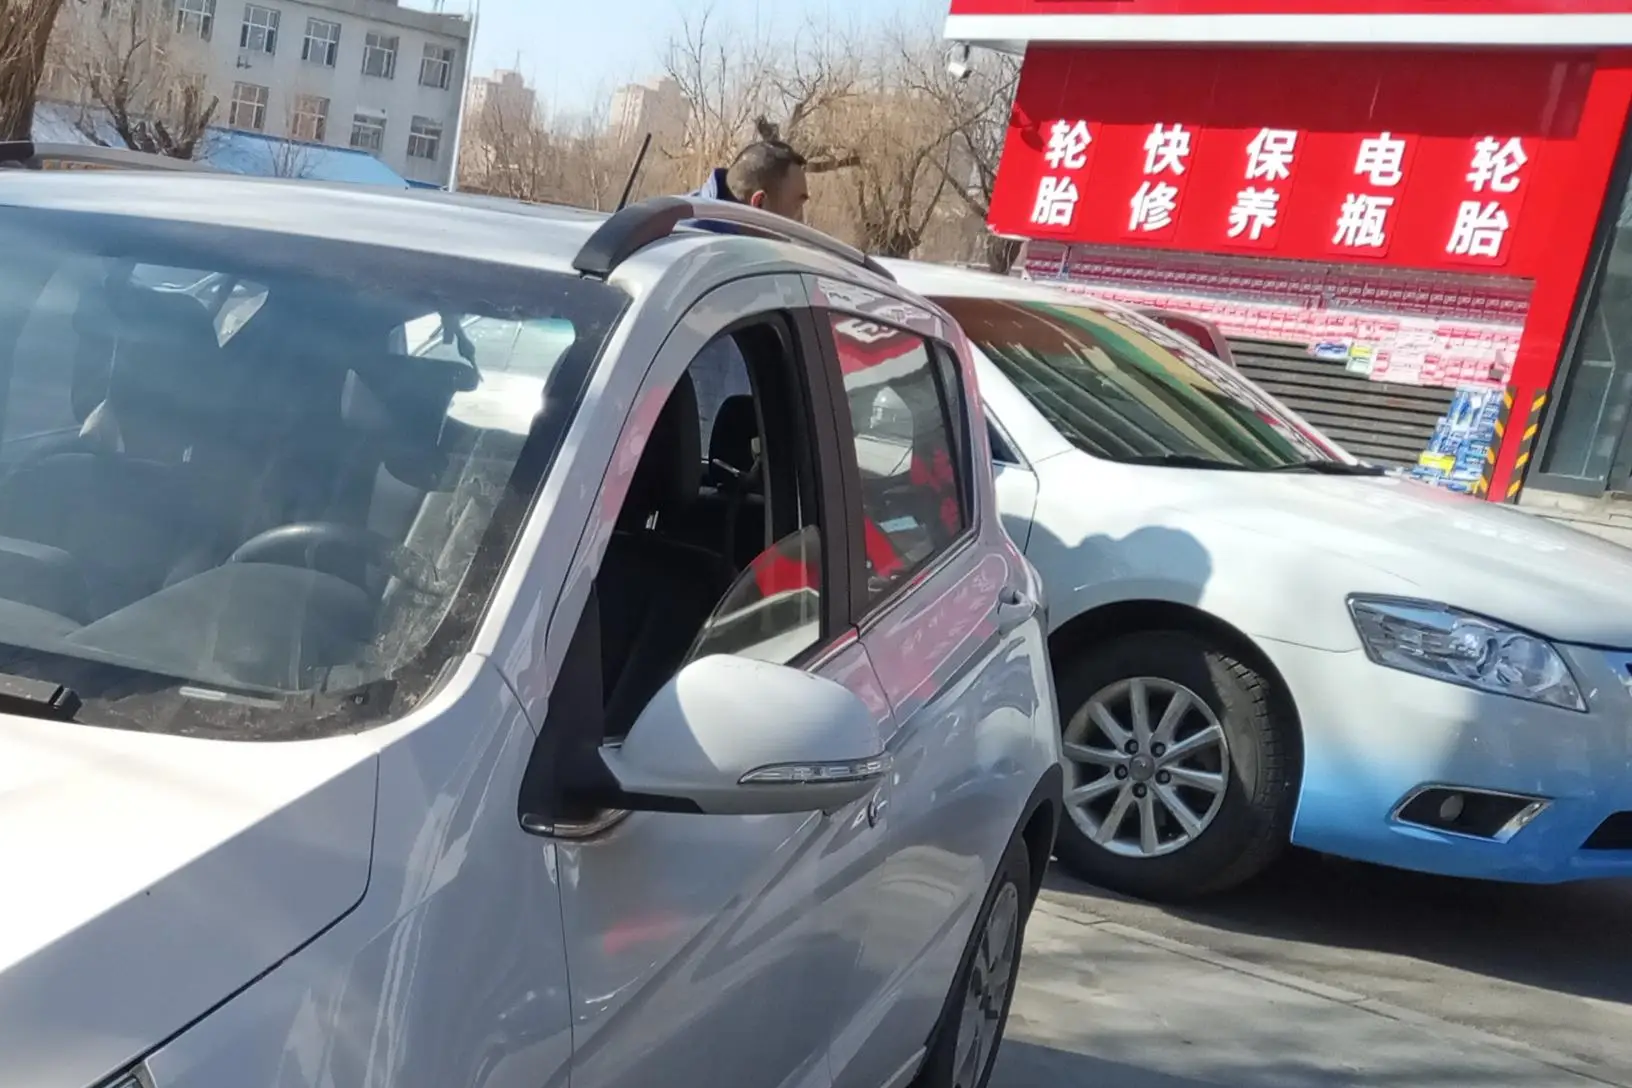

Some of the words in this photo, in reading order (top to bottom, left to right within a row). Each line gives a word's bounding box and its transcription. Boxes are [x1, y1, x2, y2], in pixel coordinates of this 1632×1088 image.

[1030, 119, 1092, 226] 轮胎
[1128, 122, 1191, 232] 快修
[1227, 127, 1298, 240] 保养
[1331, 131, 1406, 247] 电瓶
[1445, 135, 1528, 257] 轮胎
